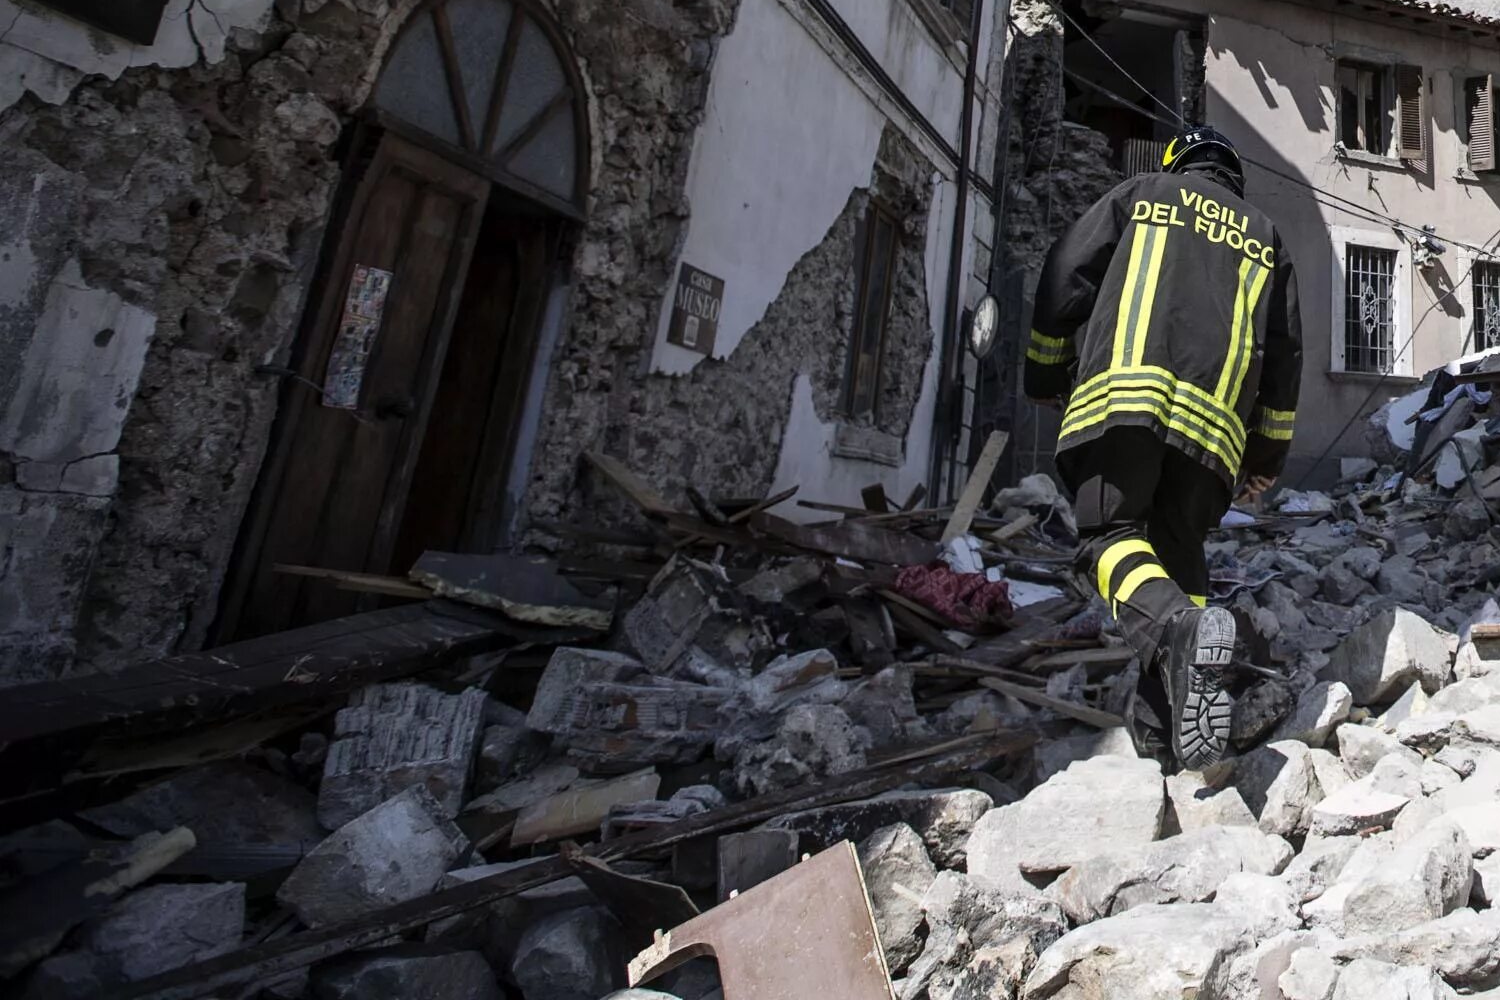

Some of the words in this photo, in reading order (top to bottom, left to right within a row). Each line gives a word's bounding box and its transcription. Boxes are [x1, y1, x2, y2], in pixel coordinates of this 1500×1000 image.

[1185, 132, 1202, 143] PE
[1179, 188, 1249, 233] VIGILI
[1131, 200, 1185, 227] DEL
[1194, 215, 1275, 269] FUOCO
[675, 283, 720, 322] MUSEO
